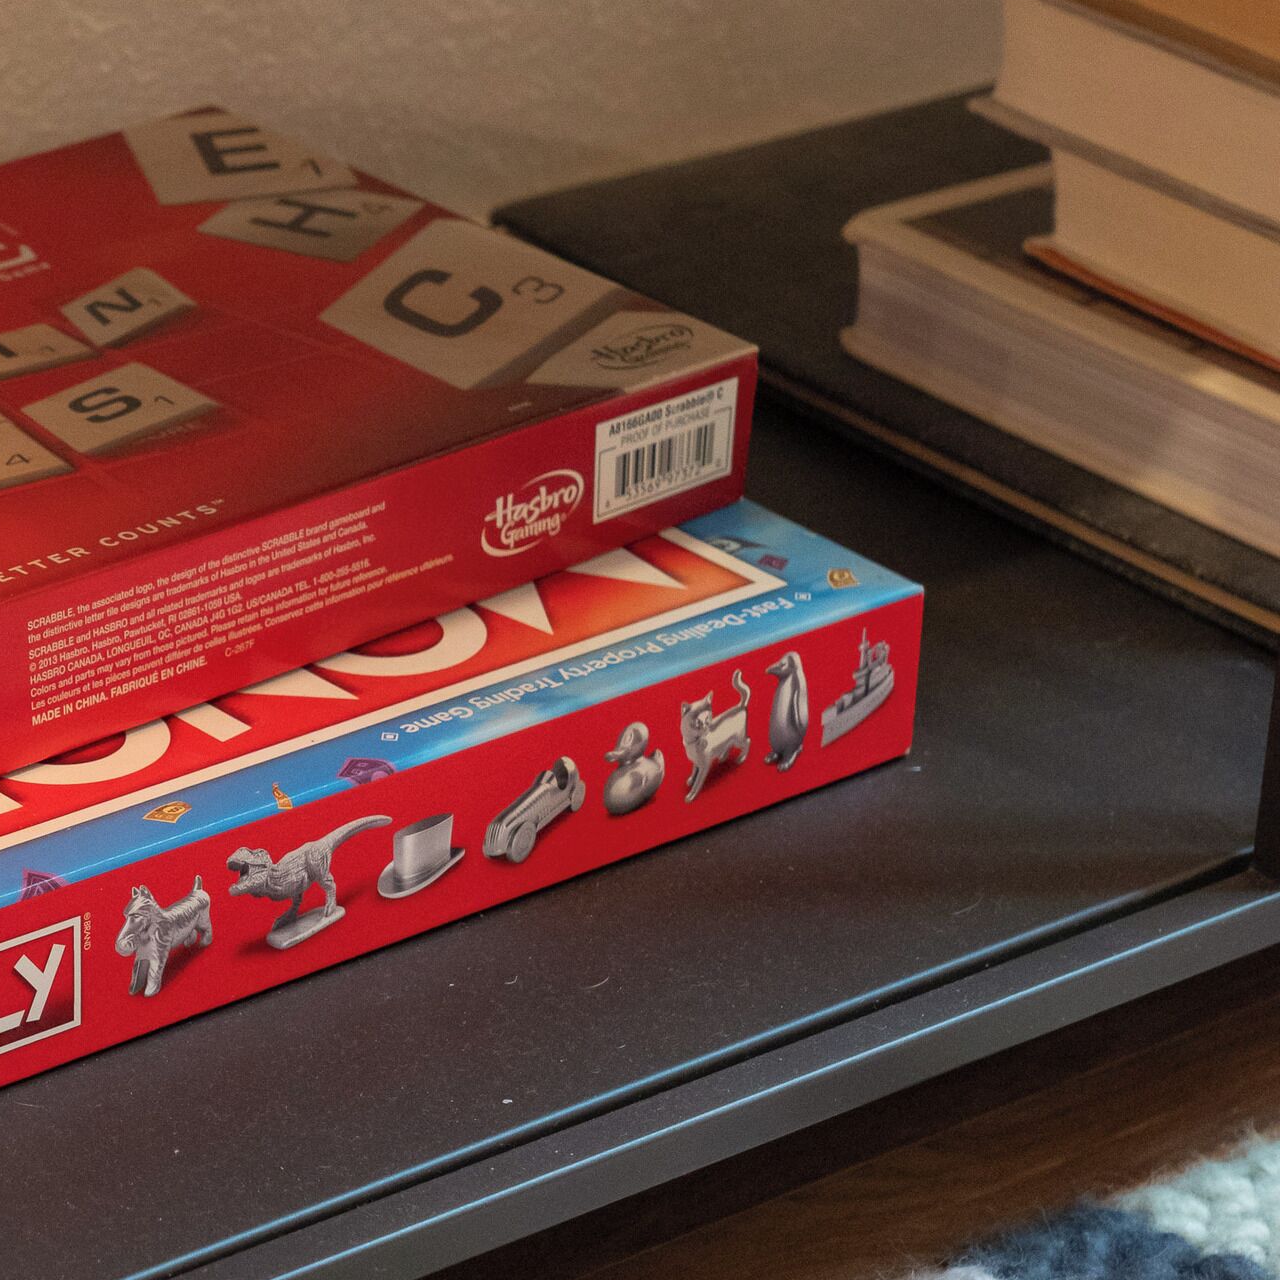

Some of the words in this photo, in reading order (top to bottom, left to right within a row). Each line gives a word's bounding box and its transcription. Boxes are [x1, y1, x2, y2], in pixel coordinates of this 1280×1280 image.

[484, 484, 578, 529] Hasbro
[77, 604, 90, 615] the
[92, 587, 134, 609] associated
[157, 577, 169, 587] the
[171, 568, 197, 583] design
[222, 547, 260, 565] distinctive
[261, 528, 305, 552] SCRABBLE
[305, 521, 328, 537] brand
[371, 500, 386, 514] and
[28, 633, 41, 644] the
[43, 619, 83, 638] distinctive
[84, 611, 105, 625] letter
[120, 596, 150, 612] designs
[166, 576, 209, 597] trademarks
[220, 562, 248, 578] Hasbro
[271, 545, 296, 560] United
[297, 537, 321, 552] States
[29, 635, 74, 660] SCRABBLE
[76, 630, 91, 644] and
[92, 618, 128, 637] HASBRO
[129, 612, 145, 625] and
[157, 599, 183, 615] related
[184, 585, 228, 606] trademarks
[229, 577, 244, 591] and
[245, 572, 266, 586] logos
[281, 552, 323, 573] trademarks
[30, 682, 57, 698] Colors
[58, 675, 73, 688] and
[74, 669, 96, 684] parts
[114, 656, 132, 668] vary
[133, 649, 152, 661] from
[152, 642, 174, 655] those
[275, 591, 317, 612] information
[655, 598, 795, 644] Fast-Dealing
[30, 665, 66, 685] HASBRO
[174, 615, 209, 634] CANADA
[38, 654, 58, 670] 2013
[560, 642, 665, 680] Property
[31, 707, 61, 726] MADE
[63, 702, 73, 715] IN
[160, 667, 174, 681] EN
[400, 698, 474, 735] Game
[470, 674, 564, 710] Trading
